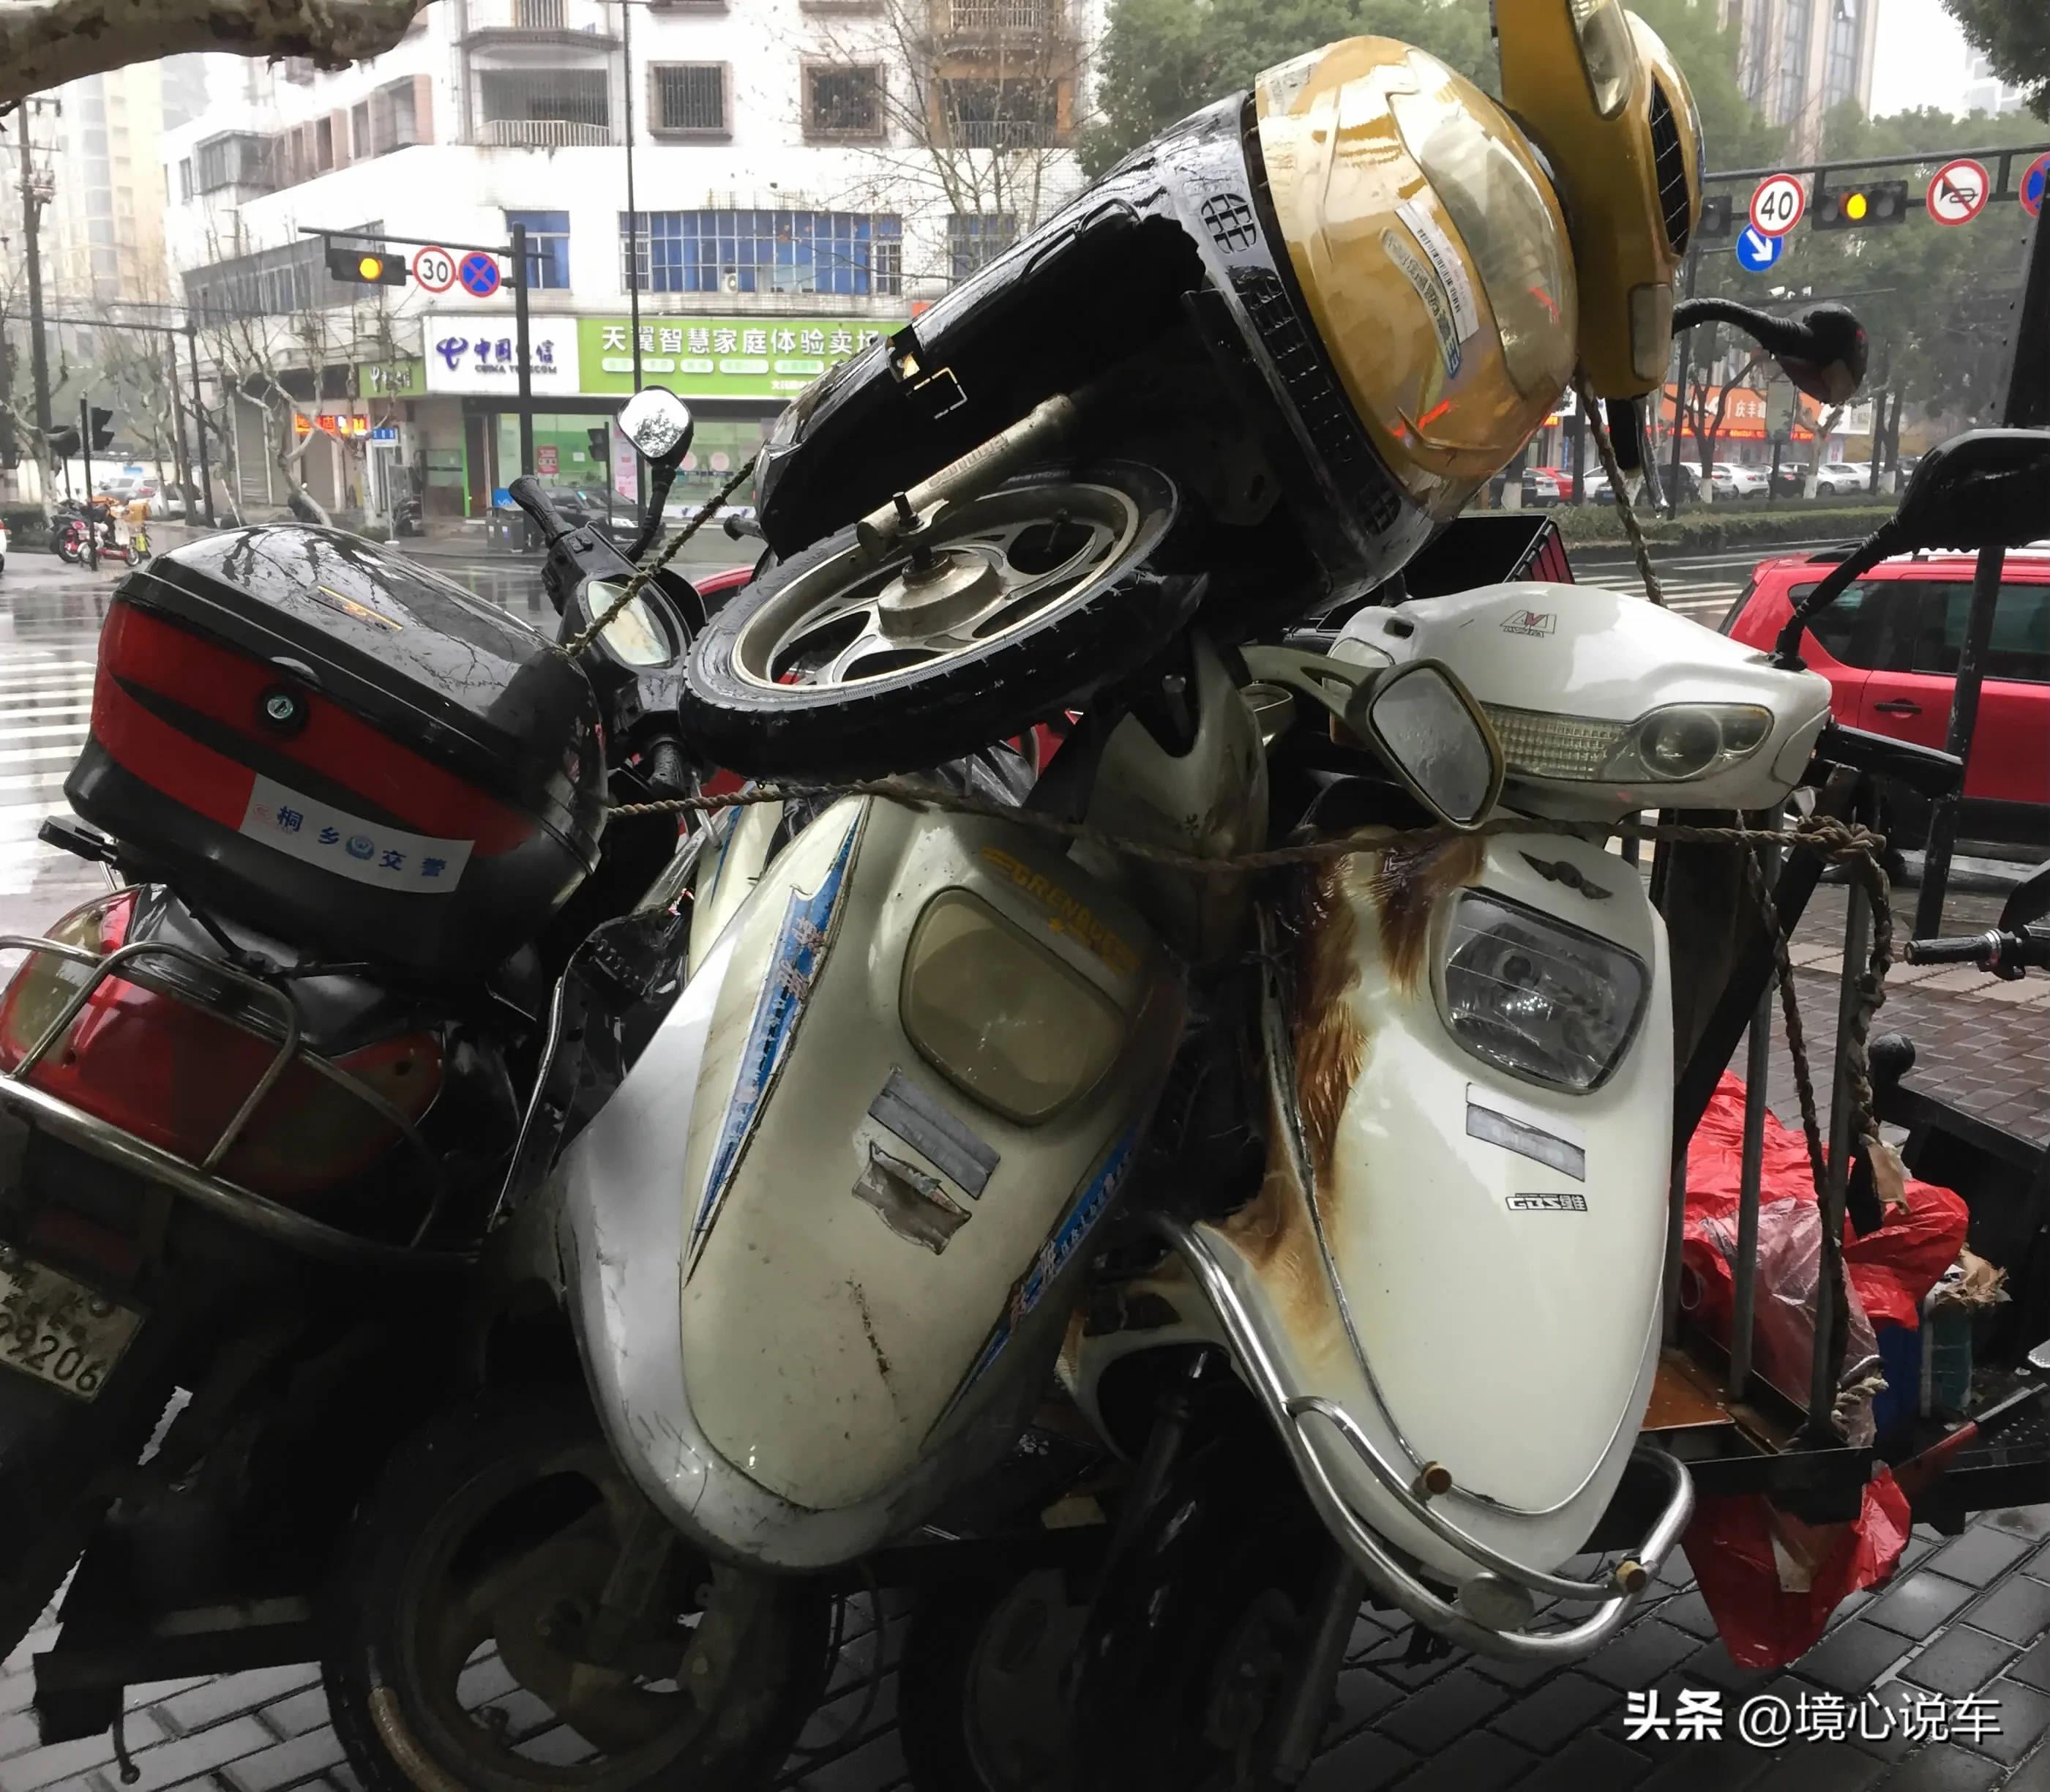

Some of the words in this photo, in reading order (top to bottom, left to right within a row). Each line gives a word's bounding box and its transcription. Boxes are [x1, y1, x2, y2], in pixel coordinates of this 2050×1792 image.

[1760, 192, 1794, 220] 40
[422, 259, 449, 283] 30
[474, 338, 555, 364] 中国信
